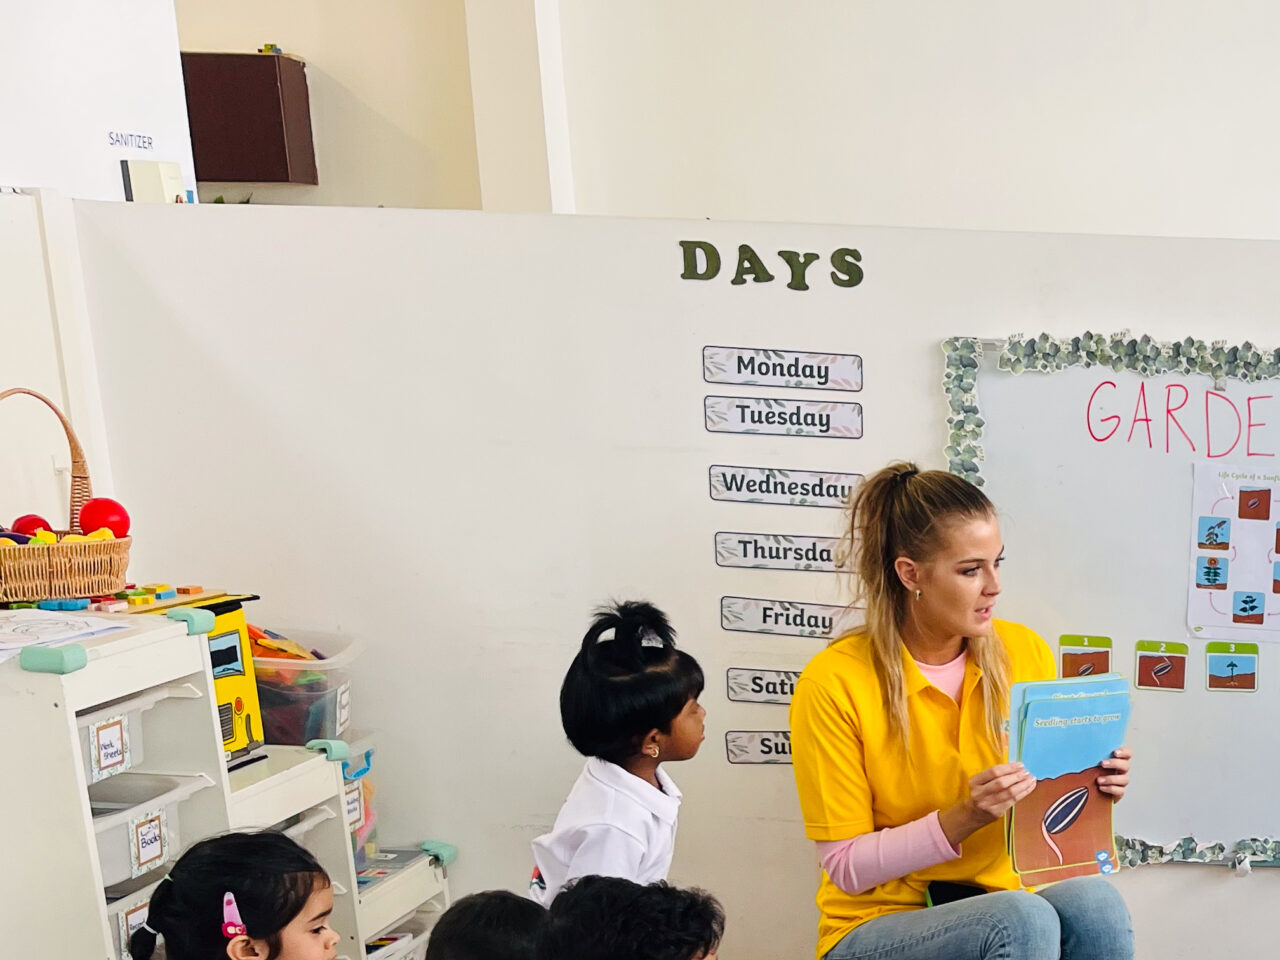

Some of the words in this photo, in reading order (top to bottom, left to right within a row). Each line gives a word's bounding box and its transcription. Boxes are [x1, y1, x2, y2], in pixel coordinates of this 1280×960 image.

[108, 131, 153, 150] SANITIZER
[679, 240, 864, 291] DAYS
[737, 355, 829, 385] Monday
[736, 404, 831, 433] Tuesday
[721, 472, 852, 504] Wednesday
[762, 606, 833, 635] Friday
[1083, 637, 1089, 645] 1
[1160, 643, 1166, 651] 2
[1229, 644, 1235, 652] 3
[1035, 718, 1067, 728] Seedling
[1070, 716, 1091, 724] starts
[1103, 713, 1121, 722] grow
[760, 737, 794, 755] Su
